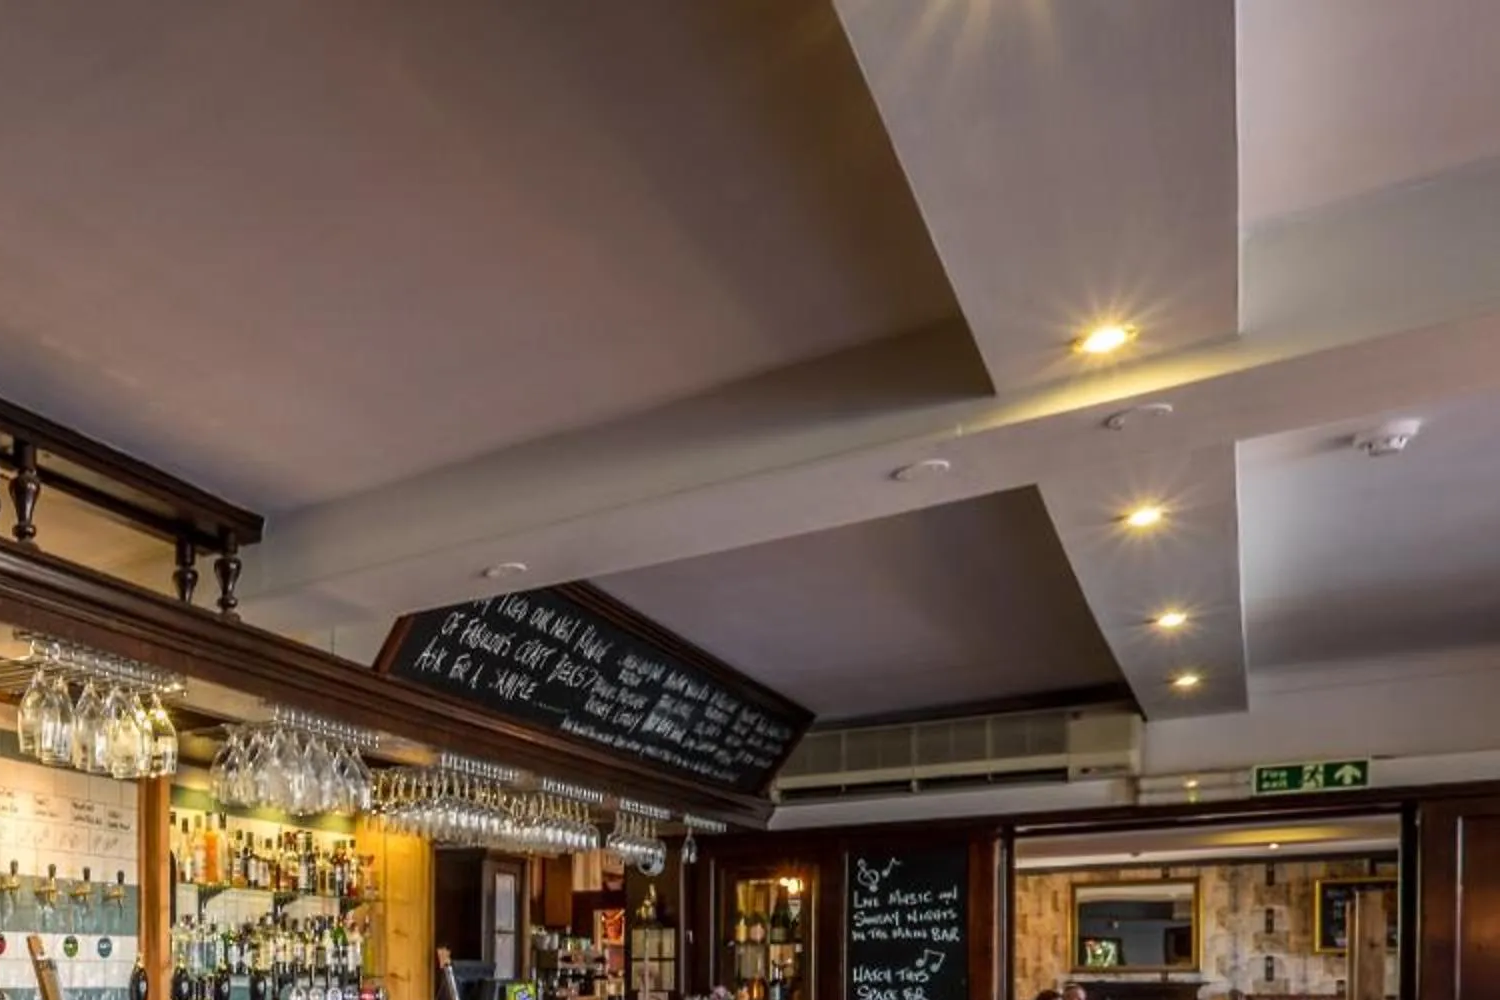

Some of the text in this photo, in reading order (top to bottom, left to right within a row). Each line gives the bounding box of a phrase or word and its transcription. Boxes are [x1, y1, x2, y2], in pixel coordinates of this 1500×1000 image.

[441, 611, 466, 635] OF
[414, 635, 448, 673] ASK
[931, 926, 960, 943] BAR
[853, 966, 892, 984] WATCH
